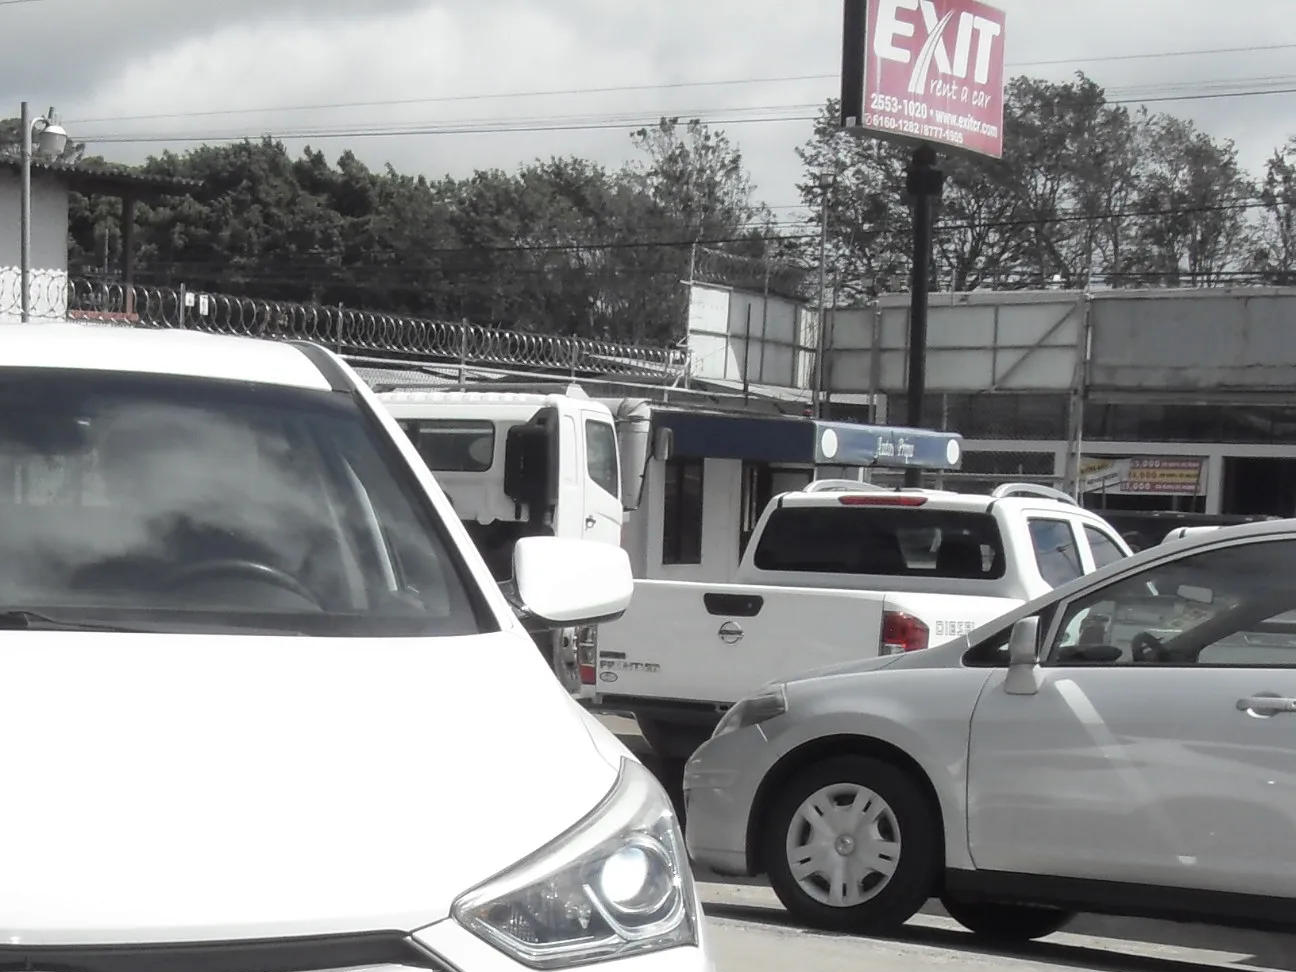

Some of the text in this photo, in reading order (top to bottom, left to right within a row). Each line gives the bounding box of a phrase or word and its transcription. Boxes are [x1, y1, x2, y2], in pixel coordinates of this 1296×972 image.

[873, 0, 1001, 95] EXIT
[870, 93, 928, 119] 2553-1020
[930, 79, 992, 110] rent a car
